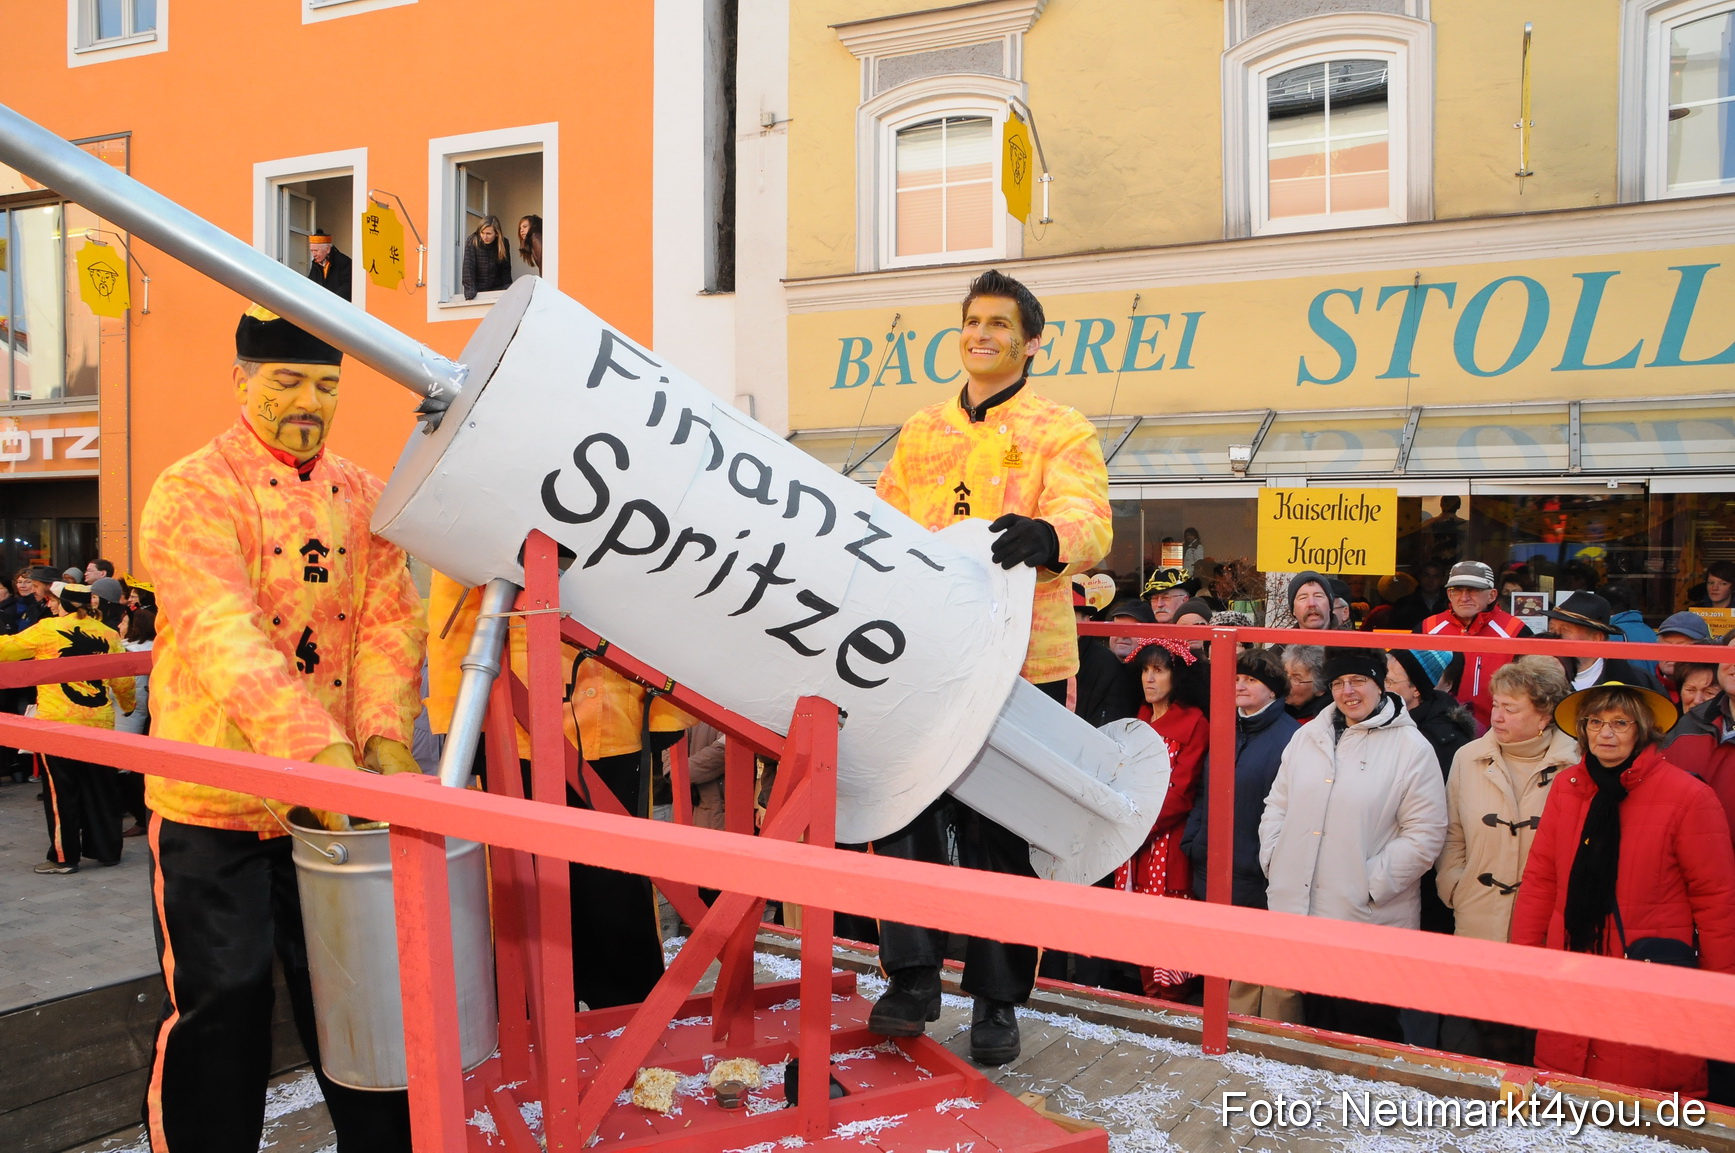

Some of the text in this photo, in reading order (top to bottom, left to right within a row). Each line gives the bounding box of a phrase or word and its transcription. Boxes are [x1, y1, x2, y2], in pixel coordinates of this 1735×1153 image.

[829, 311, 1206, 390] BÄCEREI
[586, 328, 945, 572] Finanz-
[1273, 492, 1382, 525] Kaiserliche
[540, 432, 906, 689] Spritze
[1287, 535, 1367, 573] Krapfen
